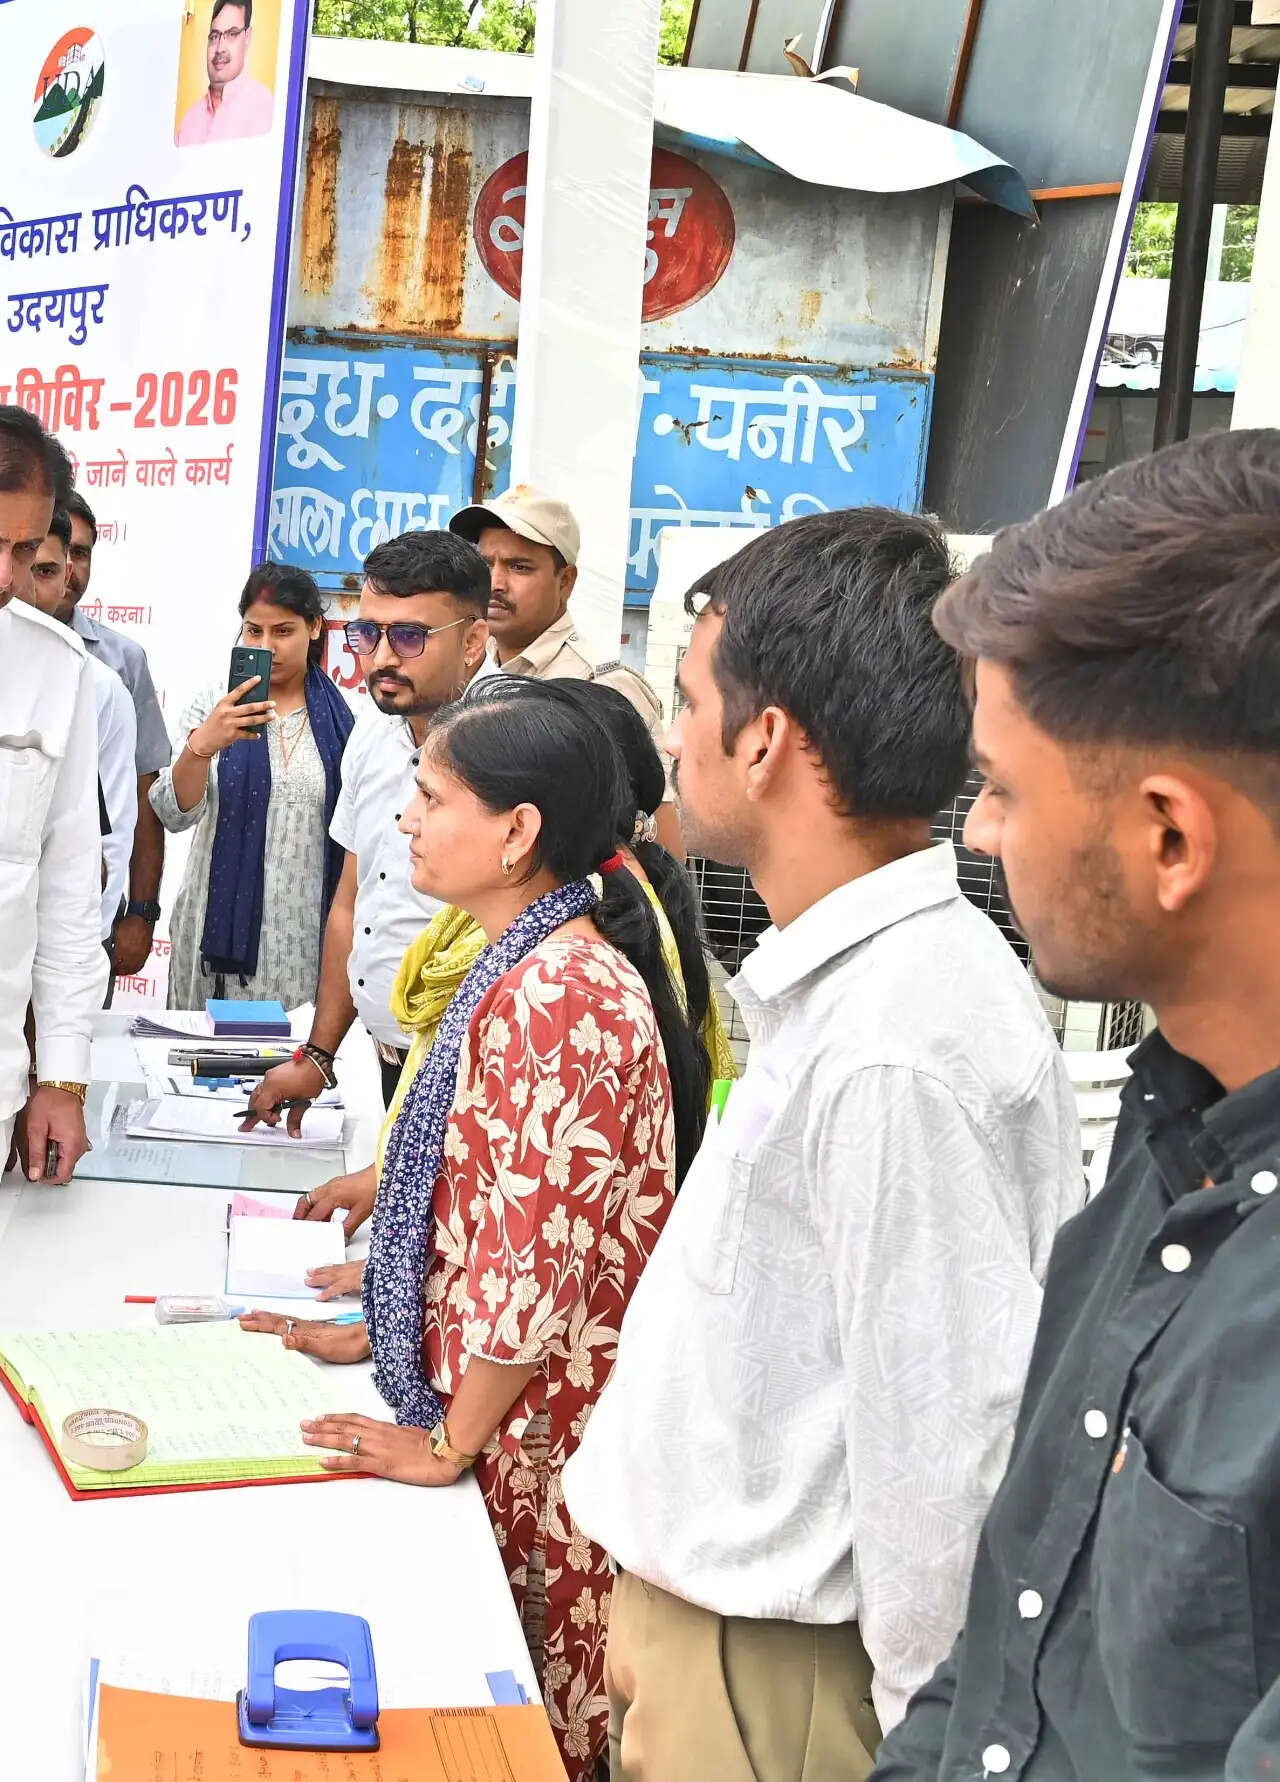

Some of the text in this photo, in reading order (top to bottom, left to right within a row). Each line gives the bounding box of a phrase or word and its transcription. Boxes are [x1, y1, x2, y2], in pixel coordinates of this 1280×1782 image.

[92, 184, 252, 251] प्राधिकरण,
[7, 283, 109, 346] उदयपुर
[690, 374, 877, 473] पनीर
[86, 448, 128, 488] जाने
[136, 446, 178, 487] वाले
[185, 443, 234, 486] कार्य
